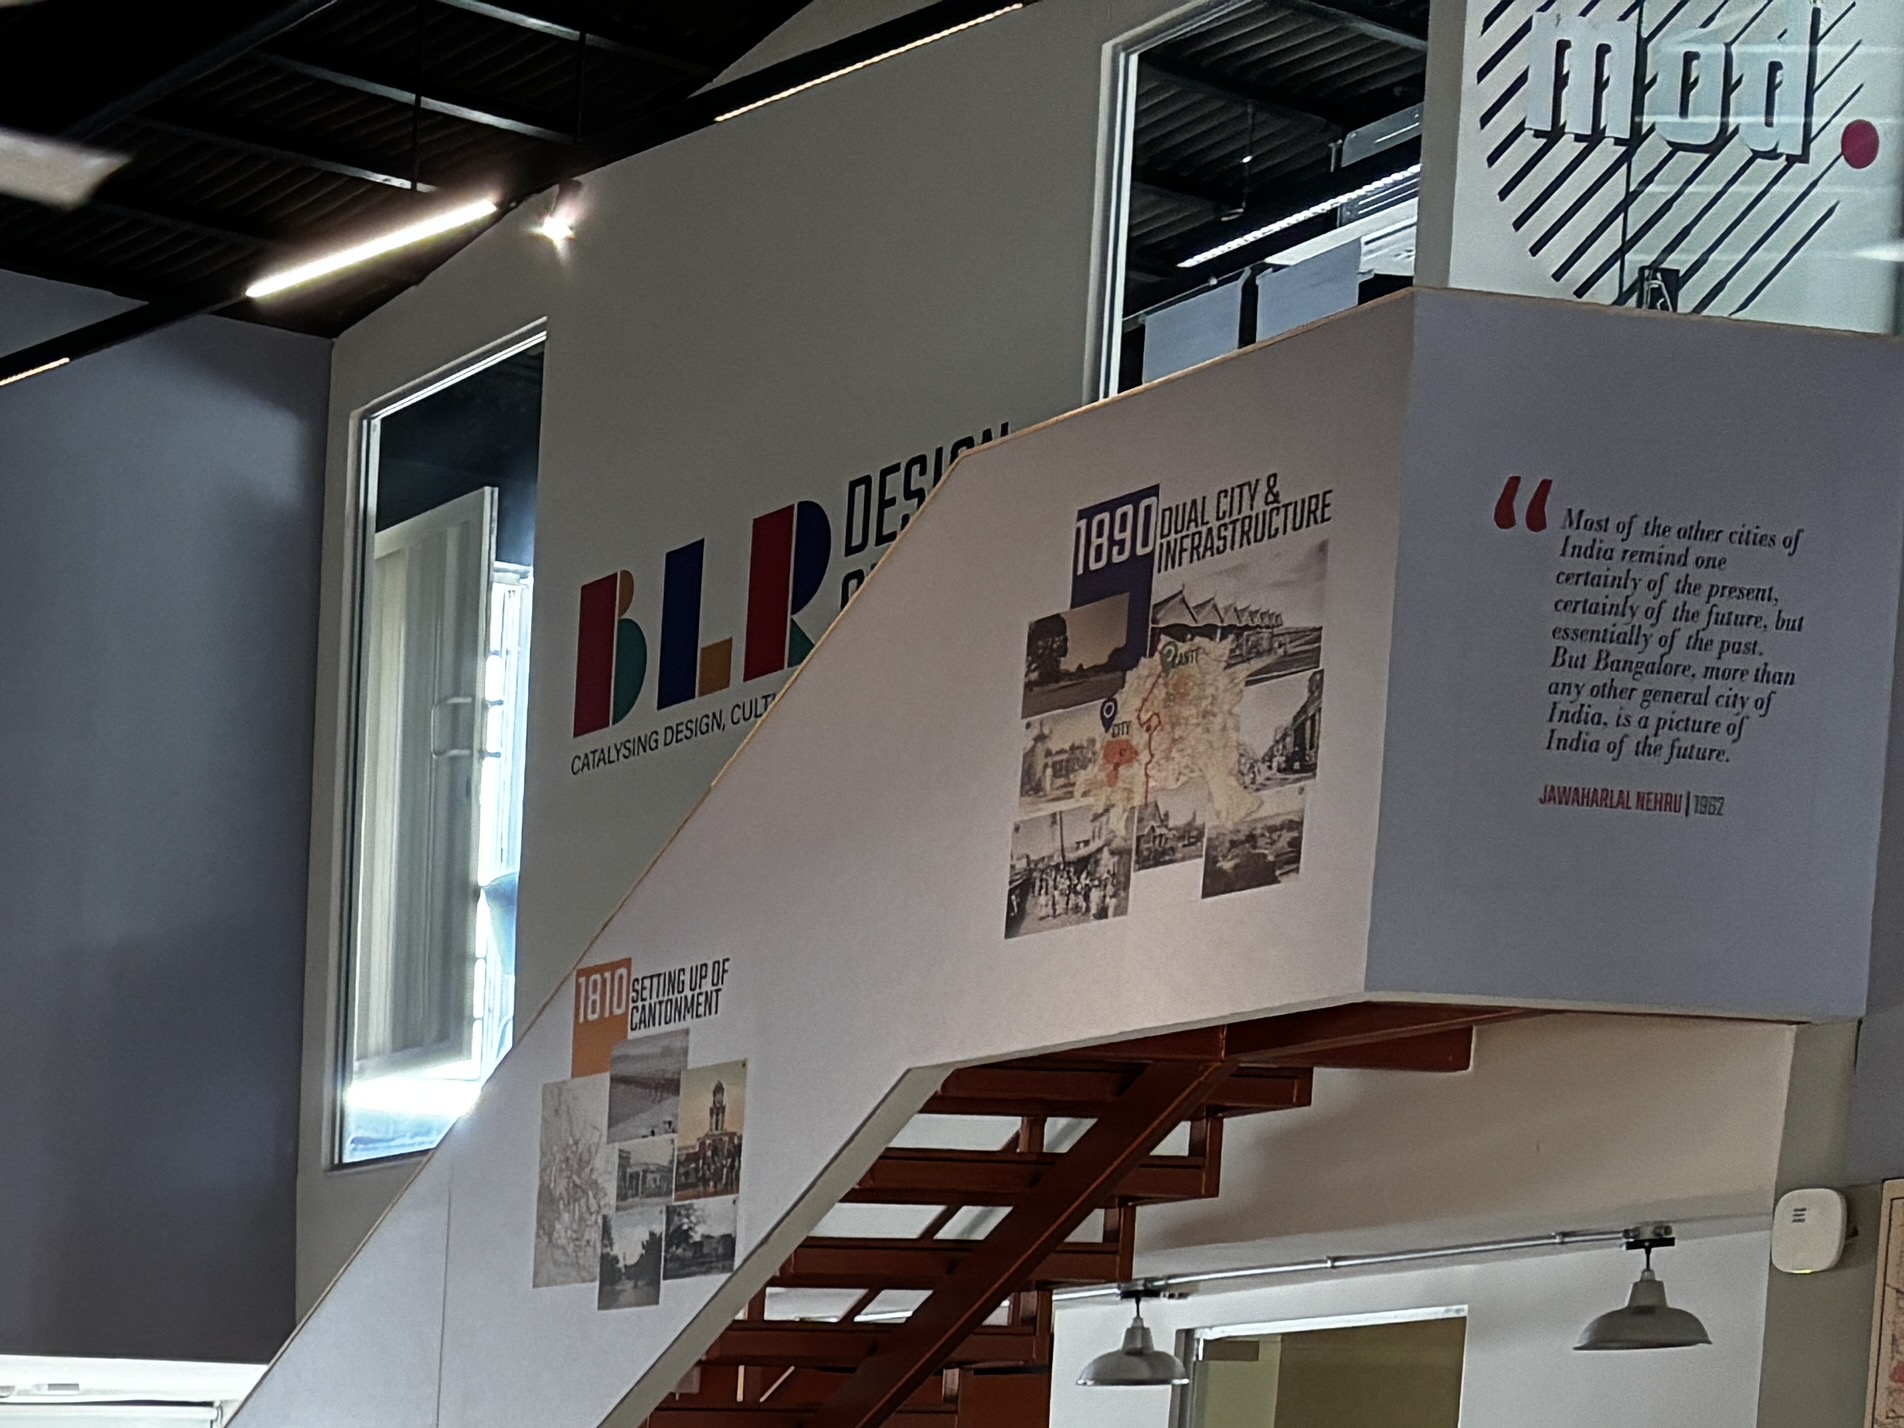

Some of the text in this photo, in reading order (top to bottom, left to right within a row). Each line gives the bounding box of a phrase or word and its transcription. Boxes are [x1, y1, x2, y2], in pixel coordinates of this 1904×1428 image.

[1074, 472, 1281, 576] 1890 DUAL CITY &
[1157, 489, 1333, 574] INFRASTRUCTURE
[1560, 507, 1805, 557] Most of the other cities of
[1559, 535, 1727, 570] India remind one
[1556, 567, 1779, 608] certainly of the present,
[572, 499, 832, 739] BLR
[1554, 595, 1640, 625] certainly
[1644, 599, 1666, 629] of
[1672, 602, 1700, 624] the
[1775, 610, 1806, 633] but
[1552, 622, 1764, 661] essentially of the past.
[1551, 645, 1587, 670] But
[1703, 664, 1749, 683] more
[1754, 662, 1796, 686] than
[1548, 677, 1777, 717] any other general city of
[570, 730, 659, 776] CATALYSING
[663, 708, 726, 748] DESIGN,
[1111, 720, 1133, 738] CITY
[1616, 706, 1633, 727] is
[1637, 715, 1649, 729] a
[1654, 710, 1721, 737] picture
[1726, 716, 1749, 743] of
[1546, 728, 1730, 765] India of the future.
[1539, 784, 1725, 817] JAWAHARLAL NEHRU 1962
[578, 957, 731, 1024] 1810 SETTING UP OF
[630, 988, 723, 1032] CANTONMENT
